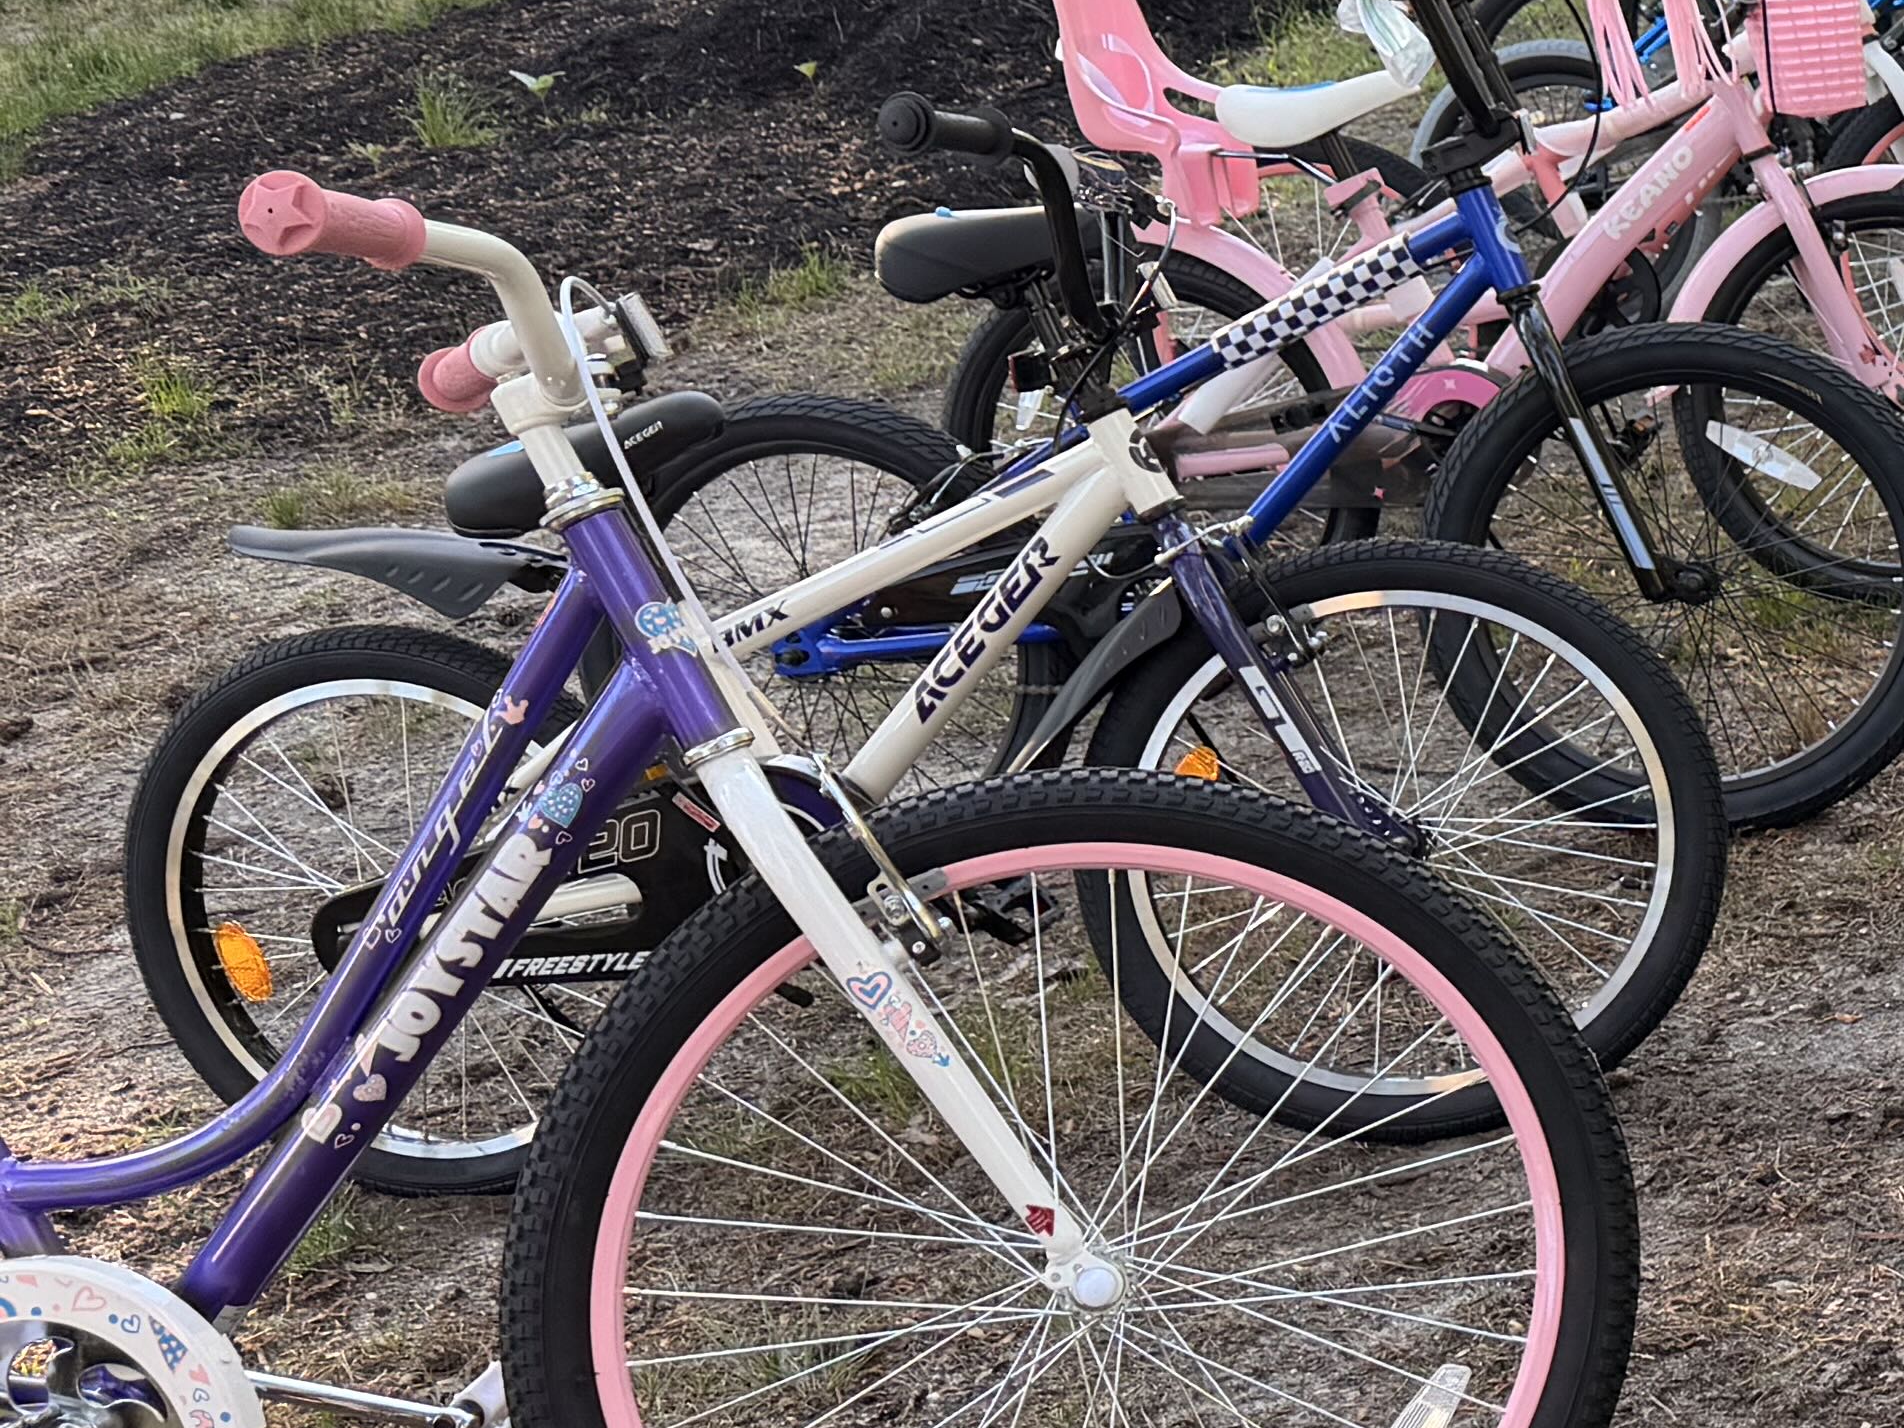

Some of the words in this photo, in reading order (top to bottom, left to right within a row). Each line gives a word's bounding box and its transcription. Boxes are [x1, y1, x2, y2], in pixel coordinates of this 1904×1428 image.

[1602, 146, 1693, 240] KEANO
[915, 536, 1061, 724] ACEGER
[375, 833, 553, 1063] JOYSTAR
[506, 950, 652, 978] FREESTYLE
